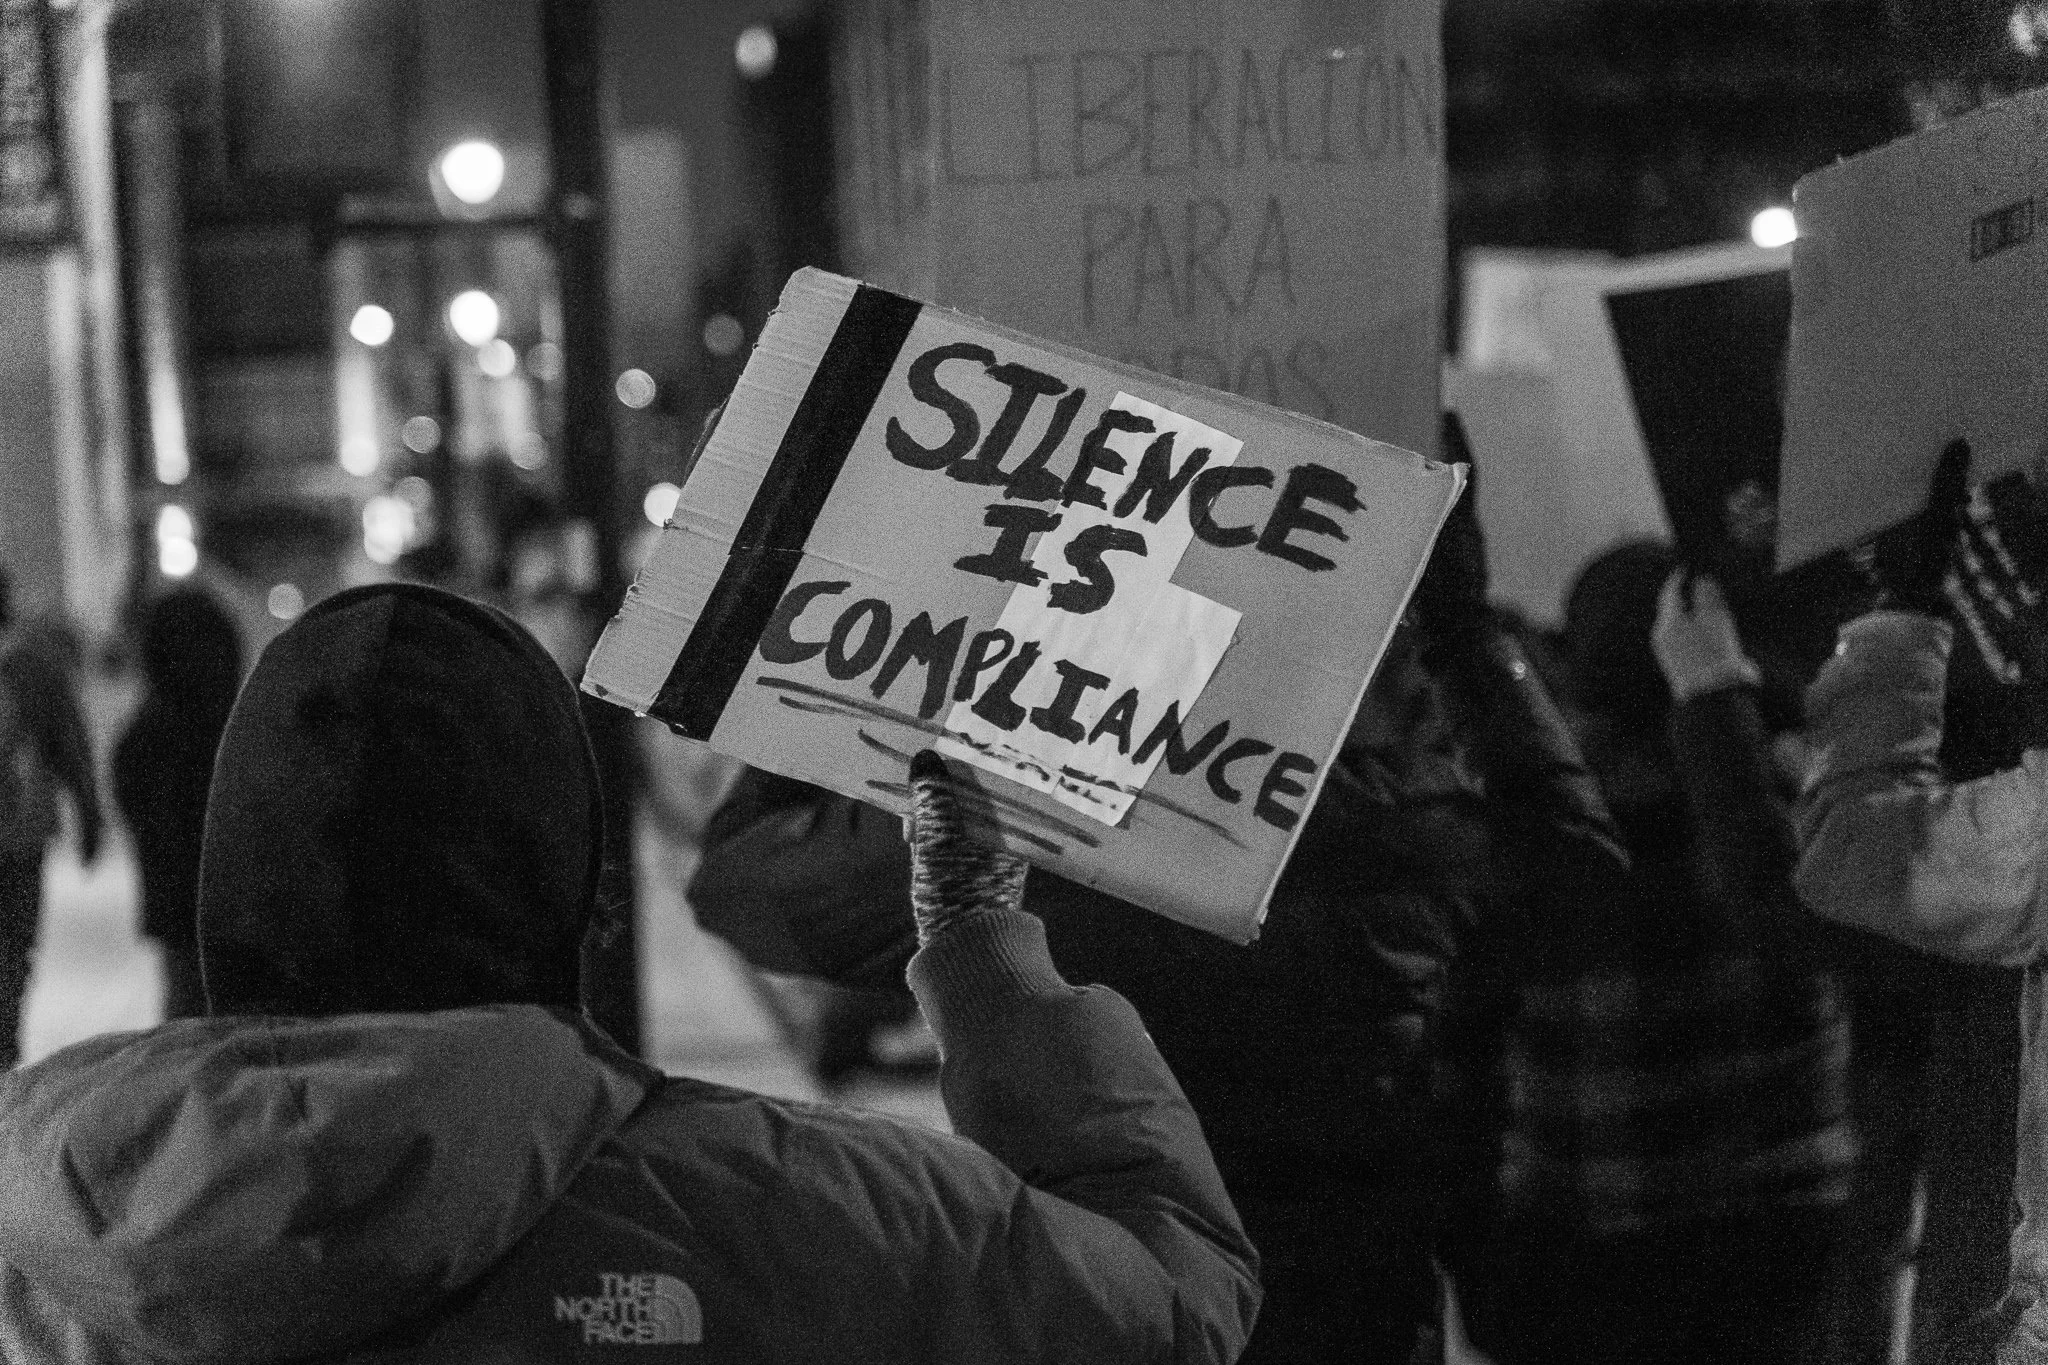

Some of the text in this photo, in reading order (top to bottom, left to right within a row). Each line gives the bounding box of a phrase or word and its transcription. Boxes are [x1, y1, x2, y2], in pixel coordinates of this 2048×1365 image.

[1081, 194, 1297, 326] PARA
[885, 341, 1367, 571] SILENCE
[952, 502, 1148, 614] IS
[757, 580, 1319, 832] COMPLIANCE
[554, 1296, 652, 1321] NORTH
[583, 1318, 654, 1344] FACE
[599, 1272, 654, 1297] THE
